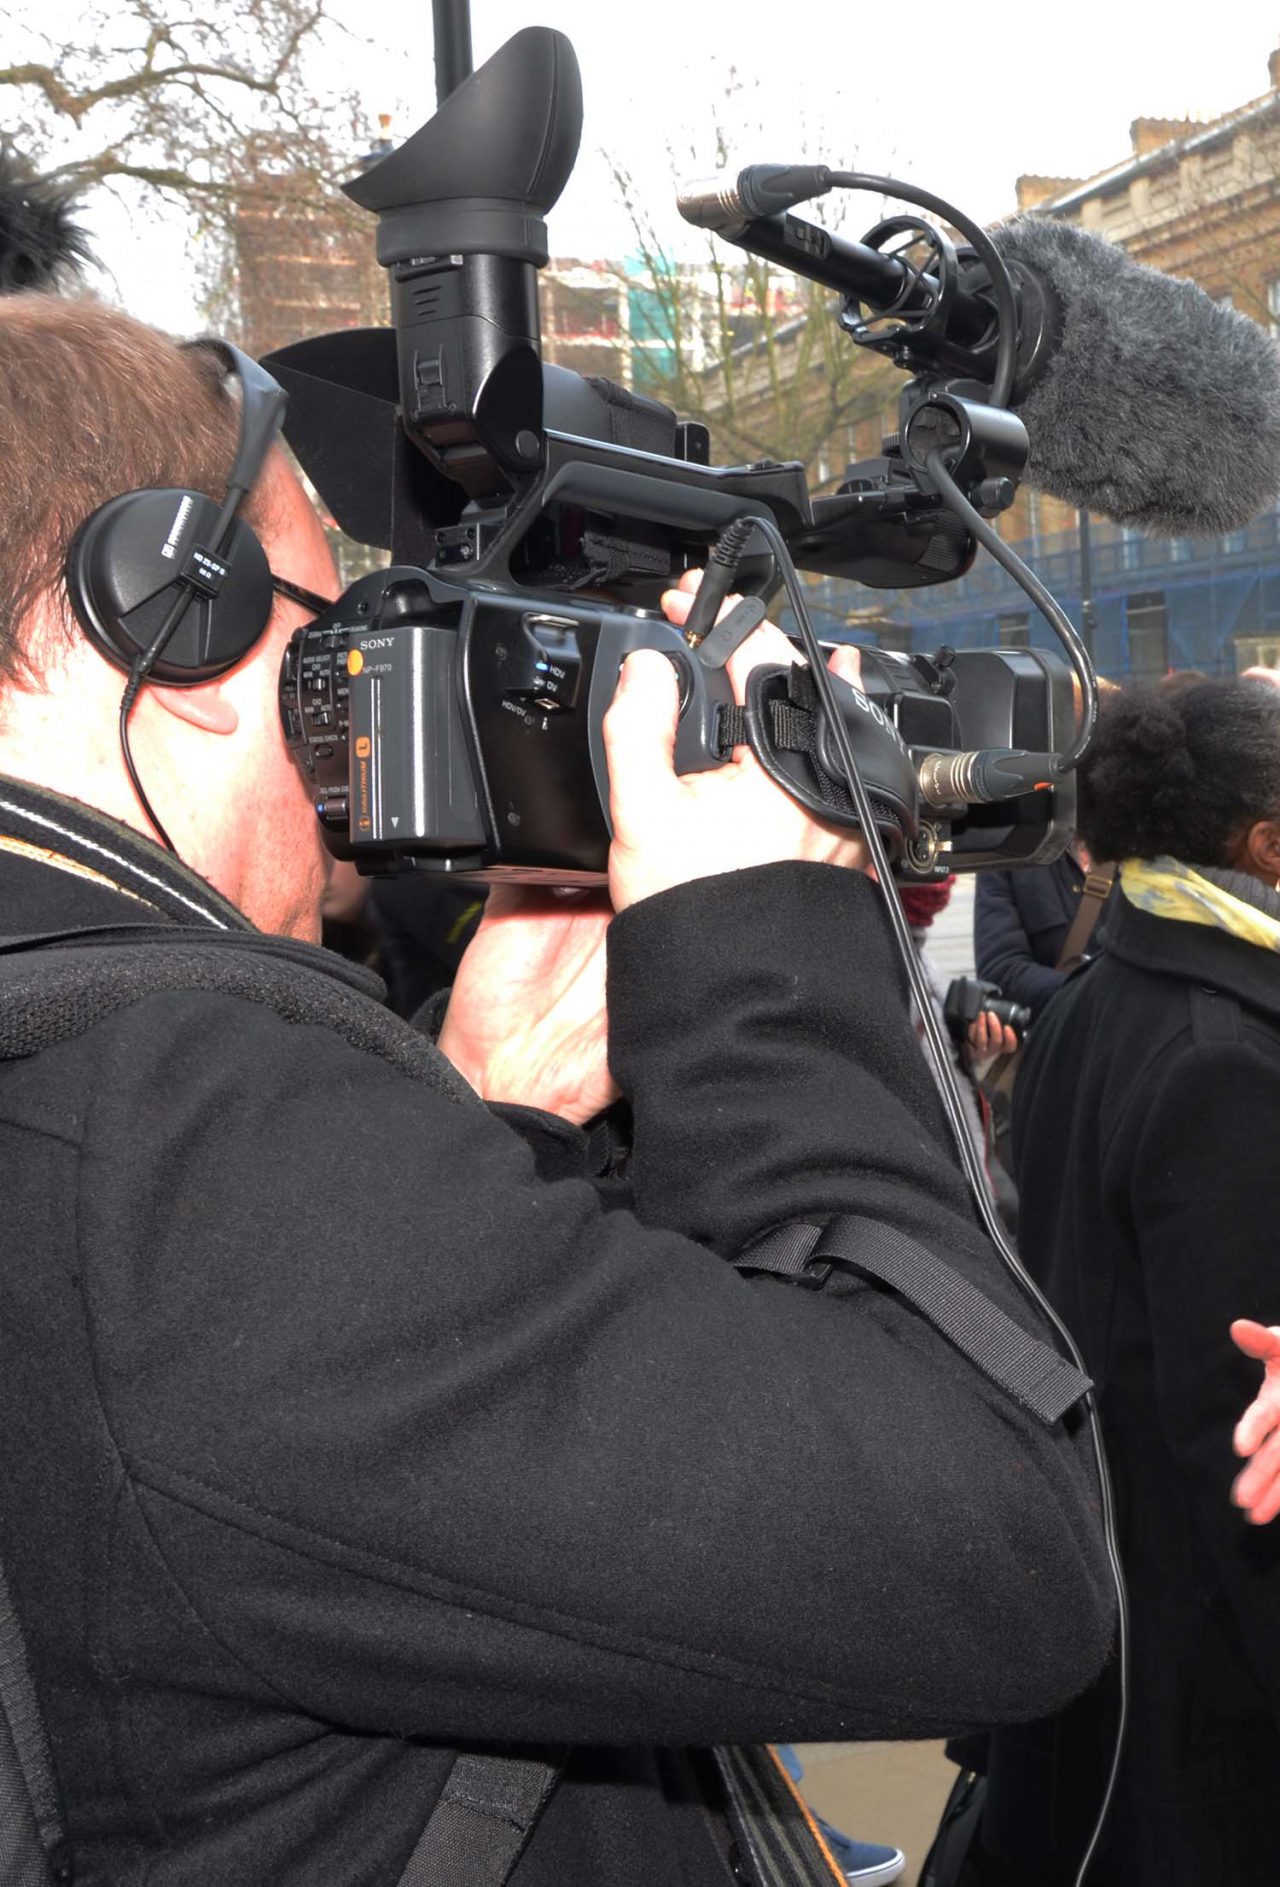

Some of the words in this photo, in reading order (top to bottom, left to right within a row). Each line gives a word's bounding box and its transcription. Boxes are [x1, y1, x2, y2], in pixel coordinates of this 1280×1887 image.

[360, 637, 395, 650] SONY
[549, 666, 566, 679] HDV
[546, 680, 558, 693] DV
